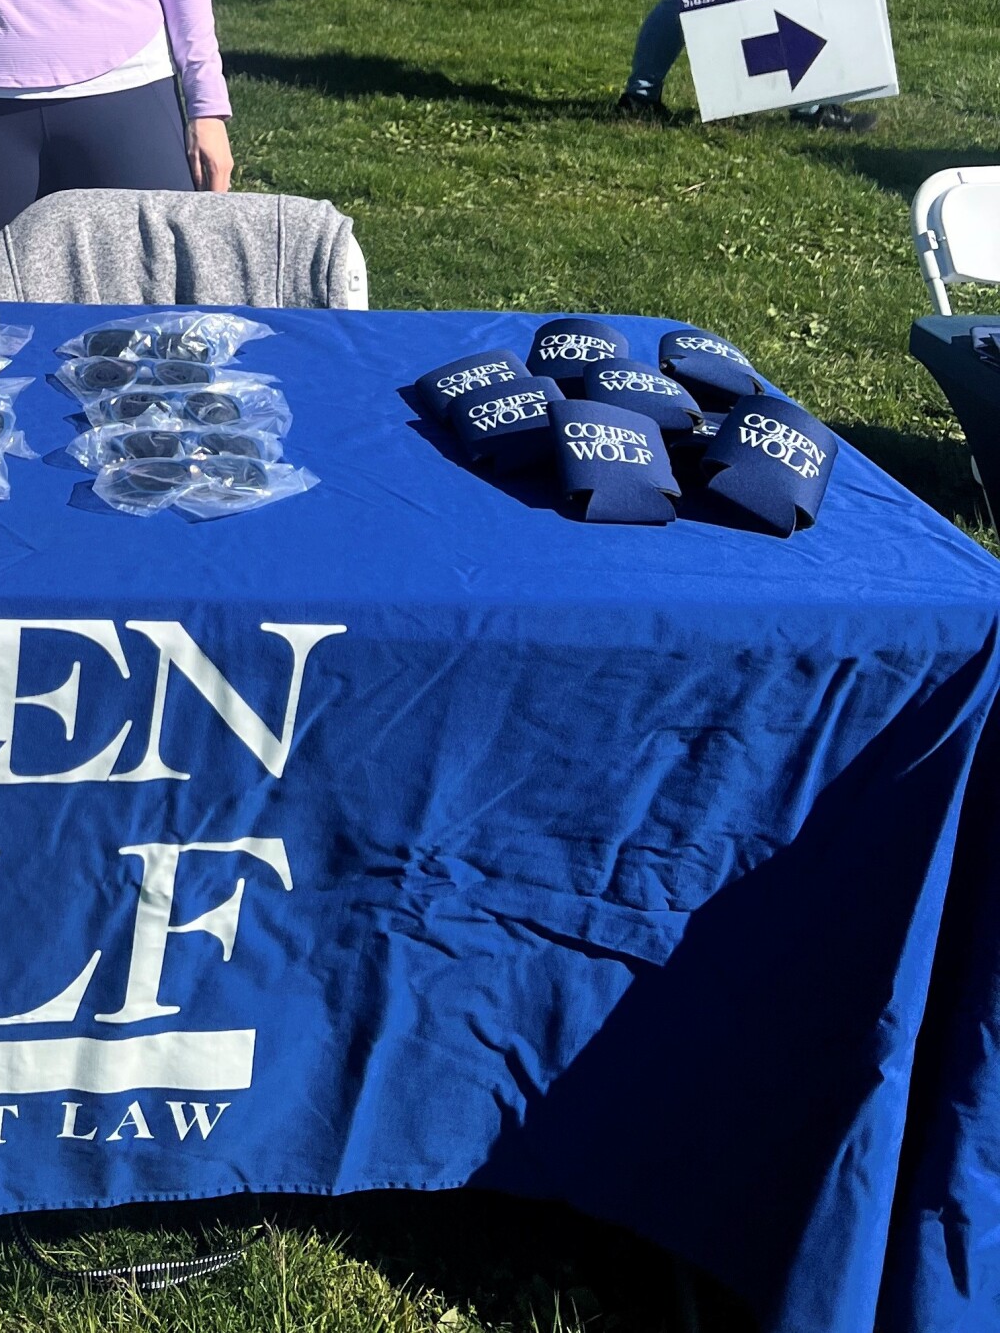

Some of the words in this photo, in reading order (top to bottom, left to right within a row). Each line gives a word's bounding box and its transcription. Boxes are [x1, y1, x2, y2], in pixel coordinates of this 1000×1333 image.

[541, 334, 617, 353] COHEN
[436, 361, 510, 388] COHEN
[598, 370, 678, 389] COHEN
[600, 381, 682, 396] WOLF
[468, 390, 546, 419] COHEN
[472, 401, 548, 432] WOLF
[564, 422, 647, 447] COHEN
[744, 413, 826, 466] COHEN
[566, 441, 654, 465] WOLF
[739, 426, 819, 478] WOLF
[55, 1100, 233, 1143] LAW
